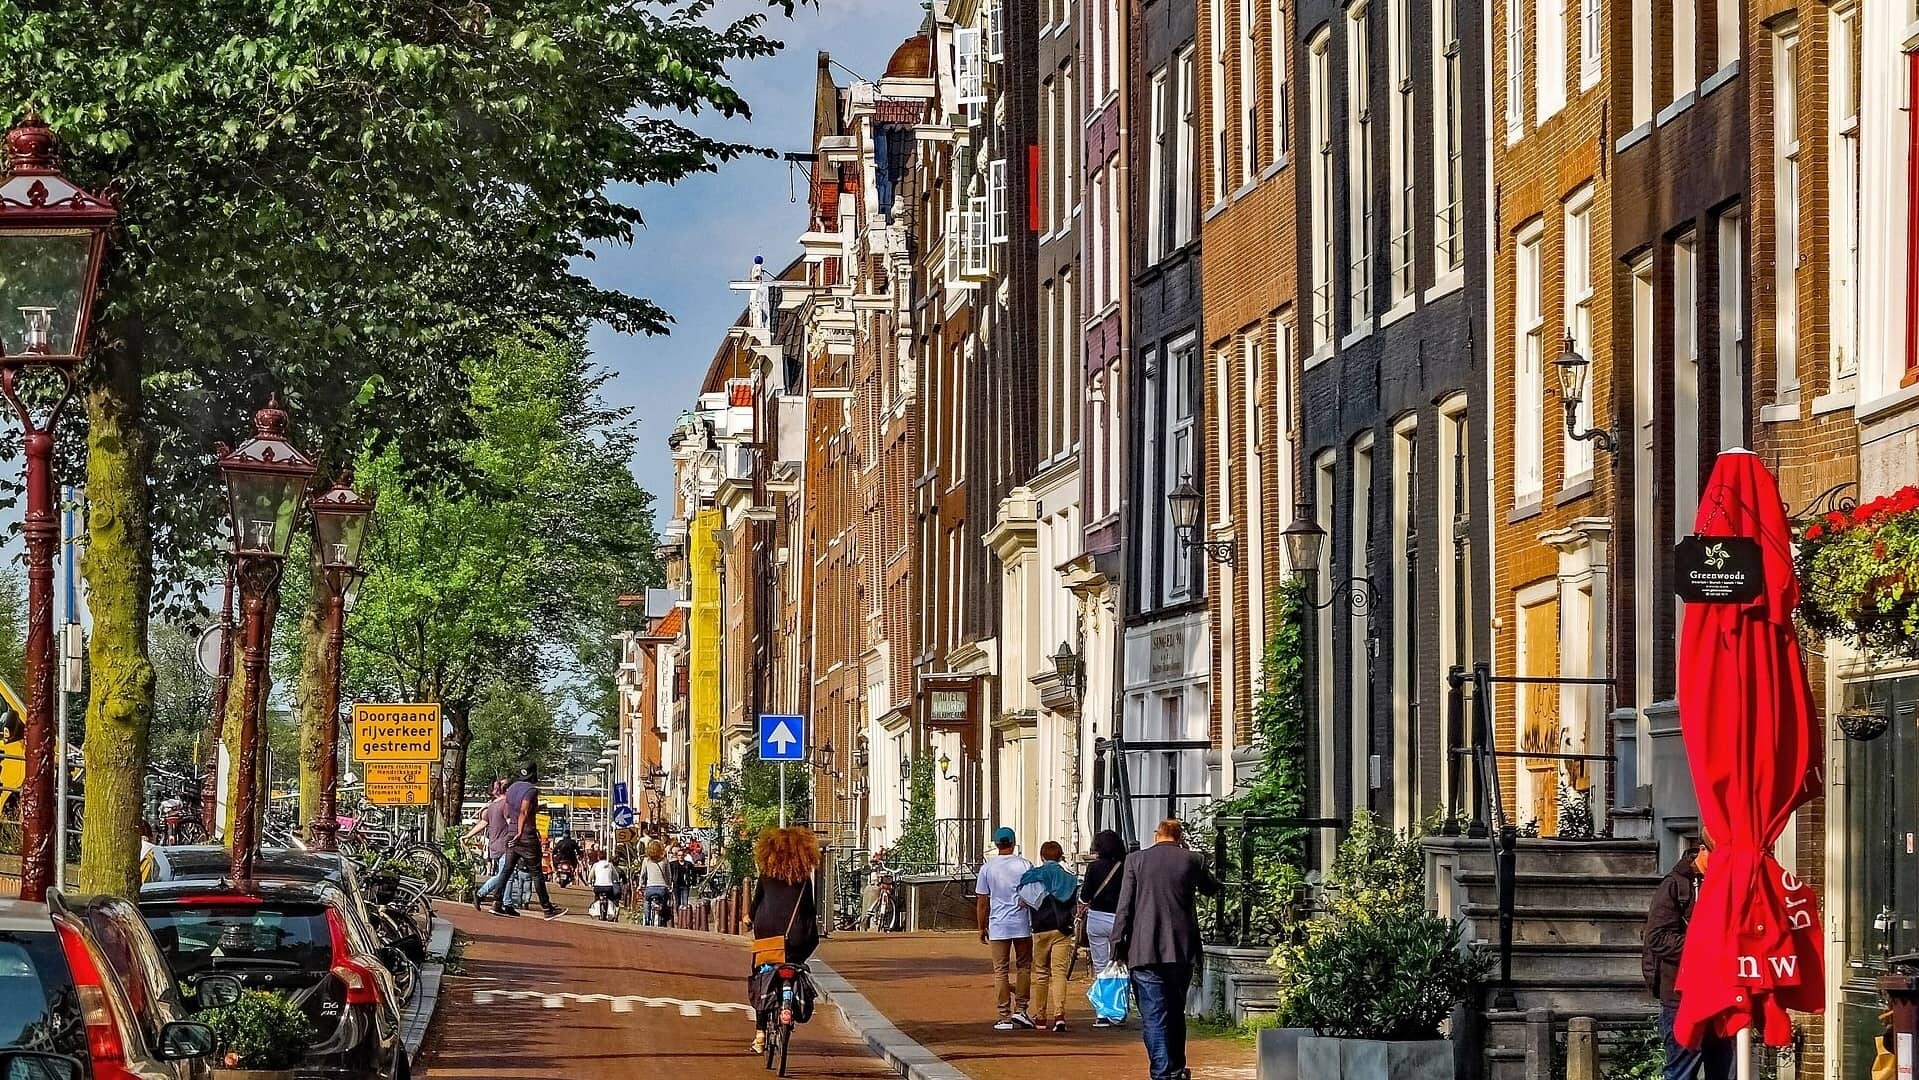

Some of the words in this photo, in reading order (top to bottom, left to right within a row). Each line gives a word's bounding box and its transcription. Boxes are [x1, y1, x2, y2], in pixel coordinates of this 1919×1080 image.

[1690, 570, 1745, 580] Greenwoods
[359, 710, 436, 725] Doorgaand
[362, 725, 434, 740] rijverkeer
[363, 740, 431, 755] gestremd
[407, 794, 413, 802] S
